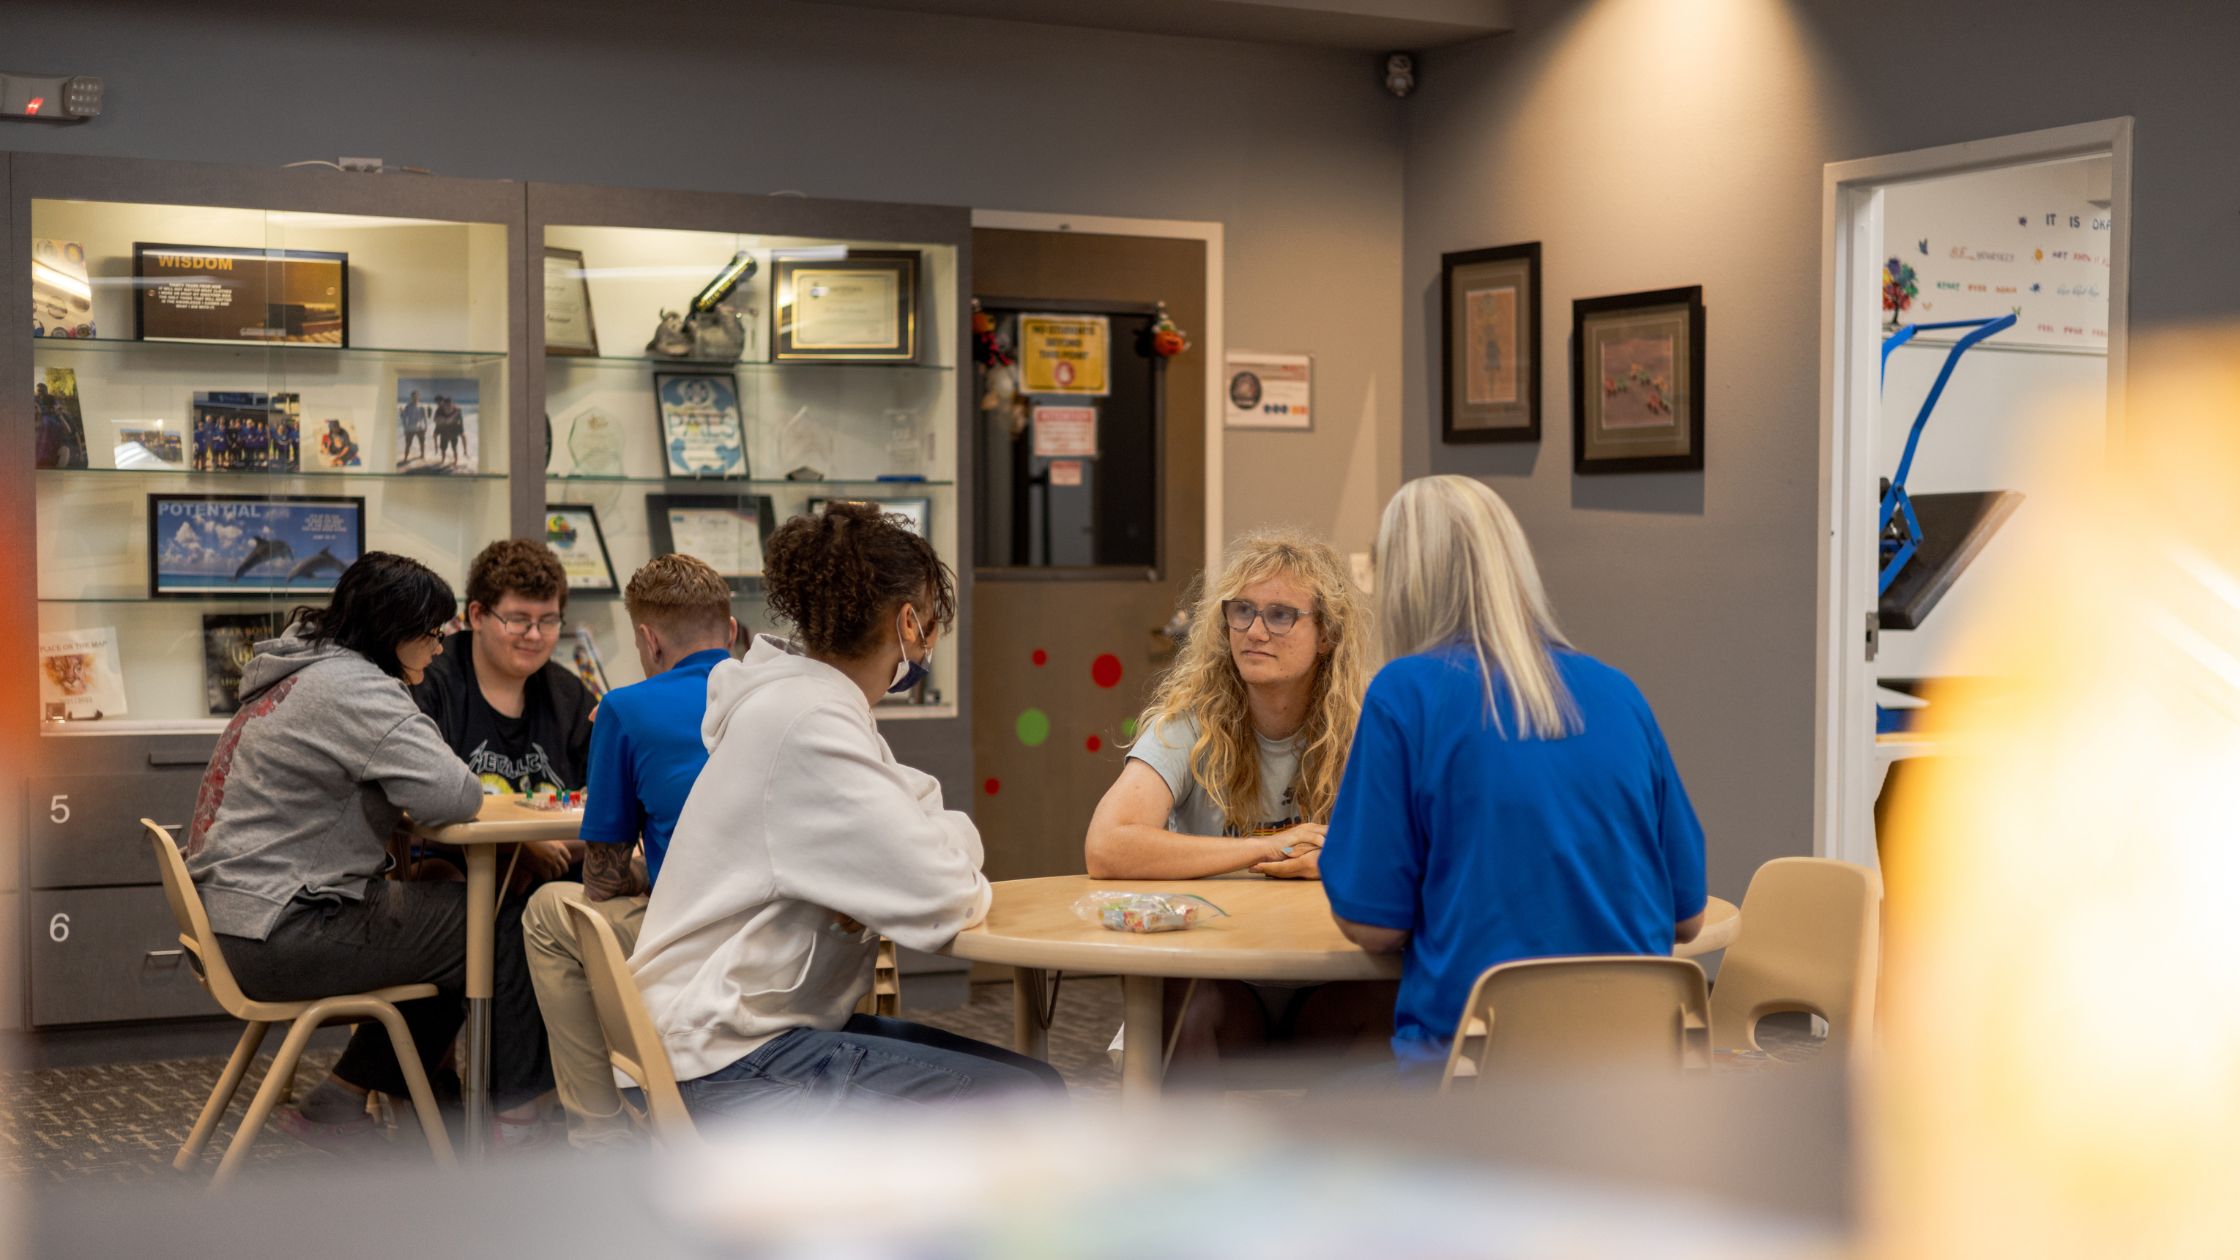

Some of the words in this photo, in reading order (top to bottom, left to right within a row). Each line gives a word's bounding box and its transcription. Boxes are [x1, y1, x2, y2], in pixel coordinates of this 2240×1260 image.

[2045, 213, 2056, 226] IT
[2069, 215, 2081, 228] IS
[2092, 218, 2111, 231] OKA
[158, 254, 233, 271] WISDOM
[158, 503, 261, 518] POTENTIAL
[50, 794, 70, 824] 5
[50, 913, 71, 942] 6
